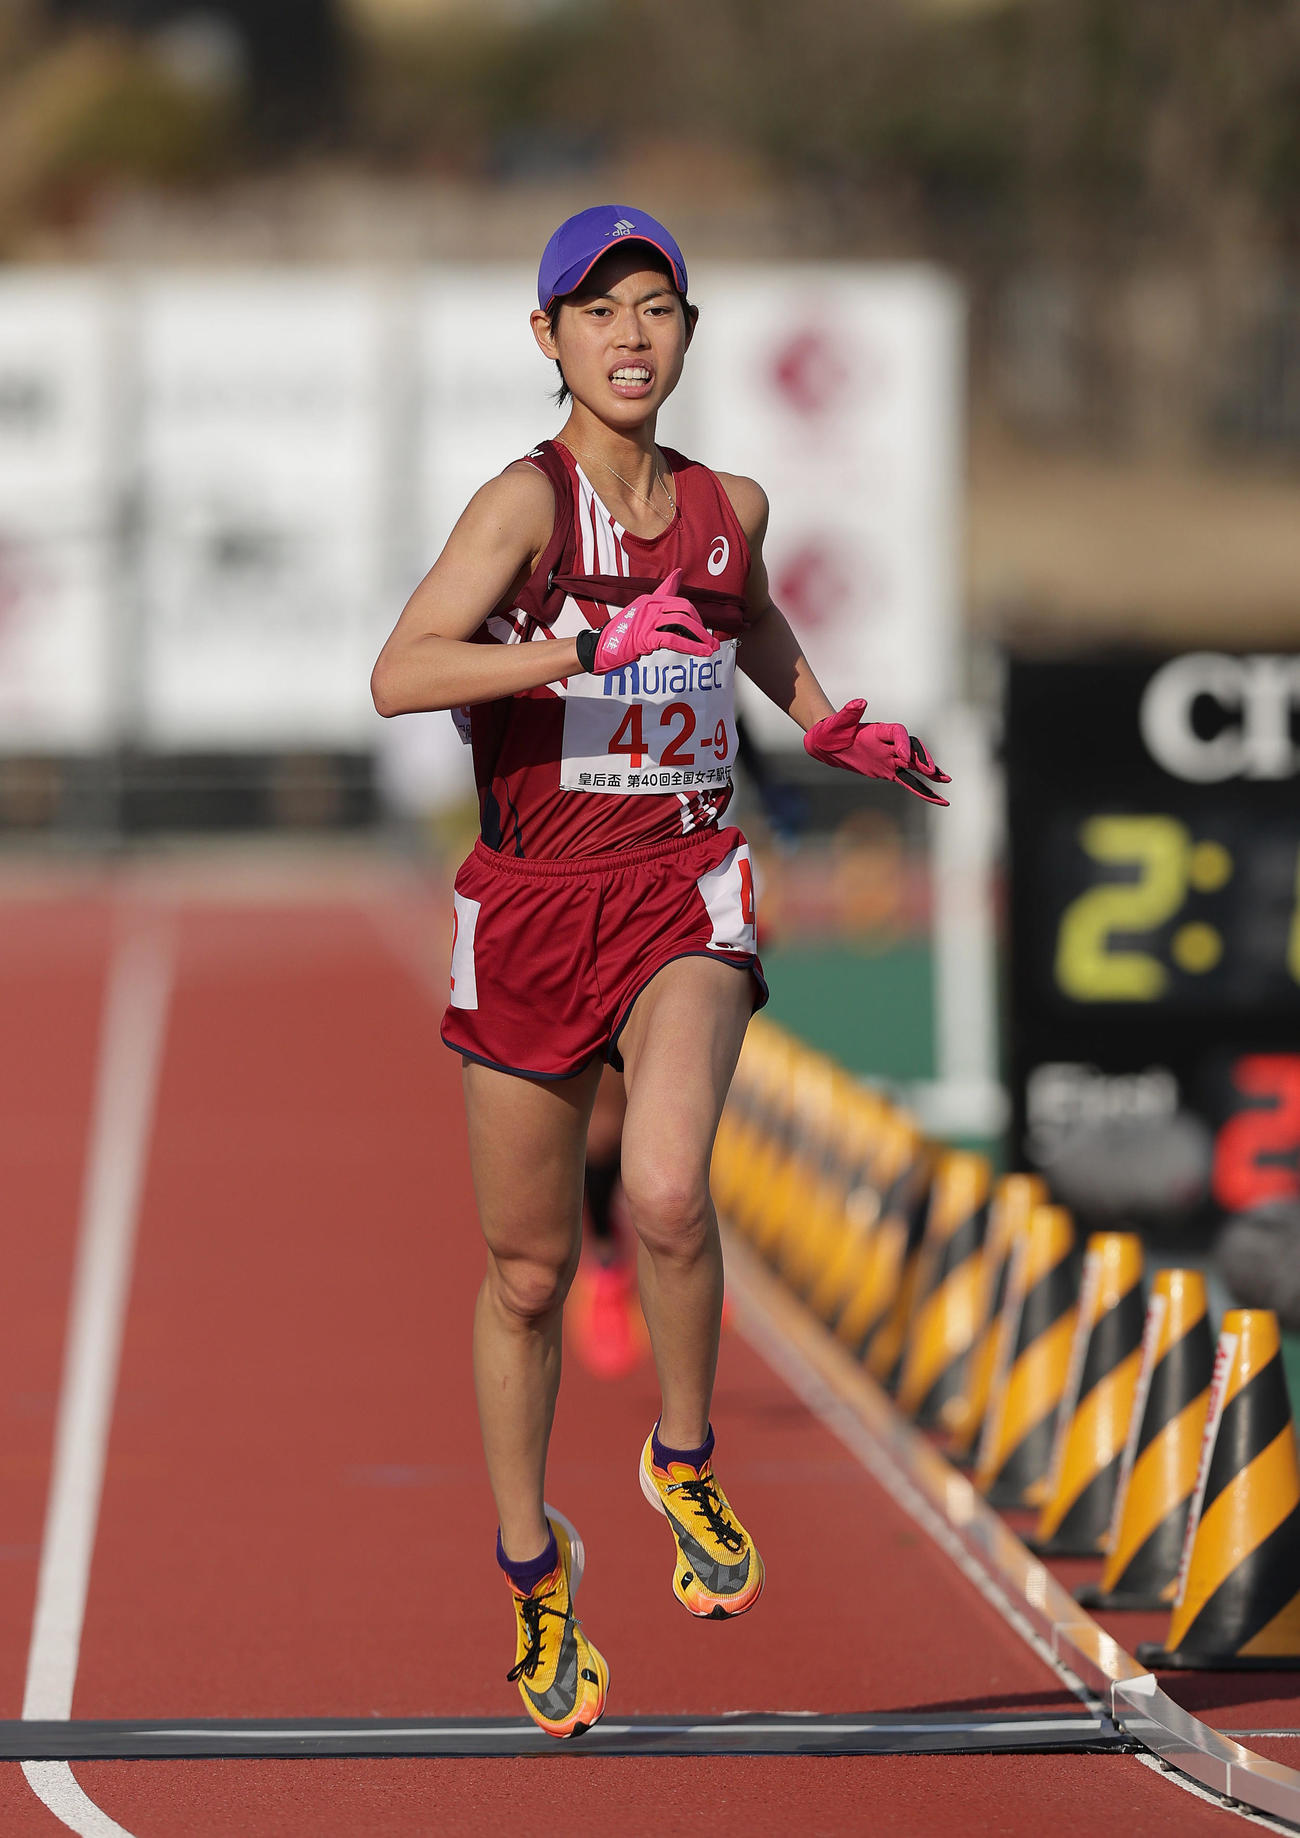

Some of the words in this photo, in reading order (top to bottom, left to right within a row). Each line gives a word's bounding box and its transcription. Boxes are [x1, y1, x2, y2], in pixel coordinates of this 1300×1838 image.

[603, 658, 722, 696] muratec
[1140, 651, 1300, 783] CI
[578, 772, 622, 787] 皇后盃
[1054, 814, 1300, 1002] 2:
[1214, 1054, 1300, 1211] 2
